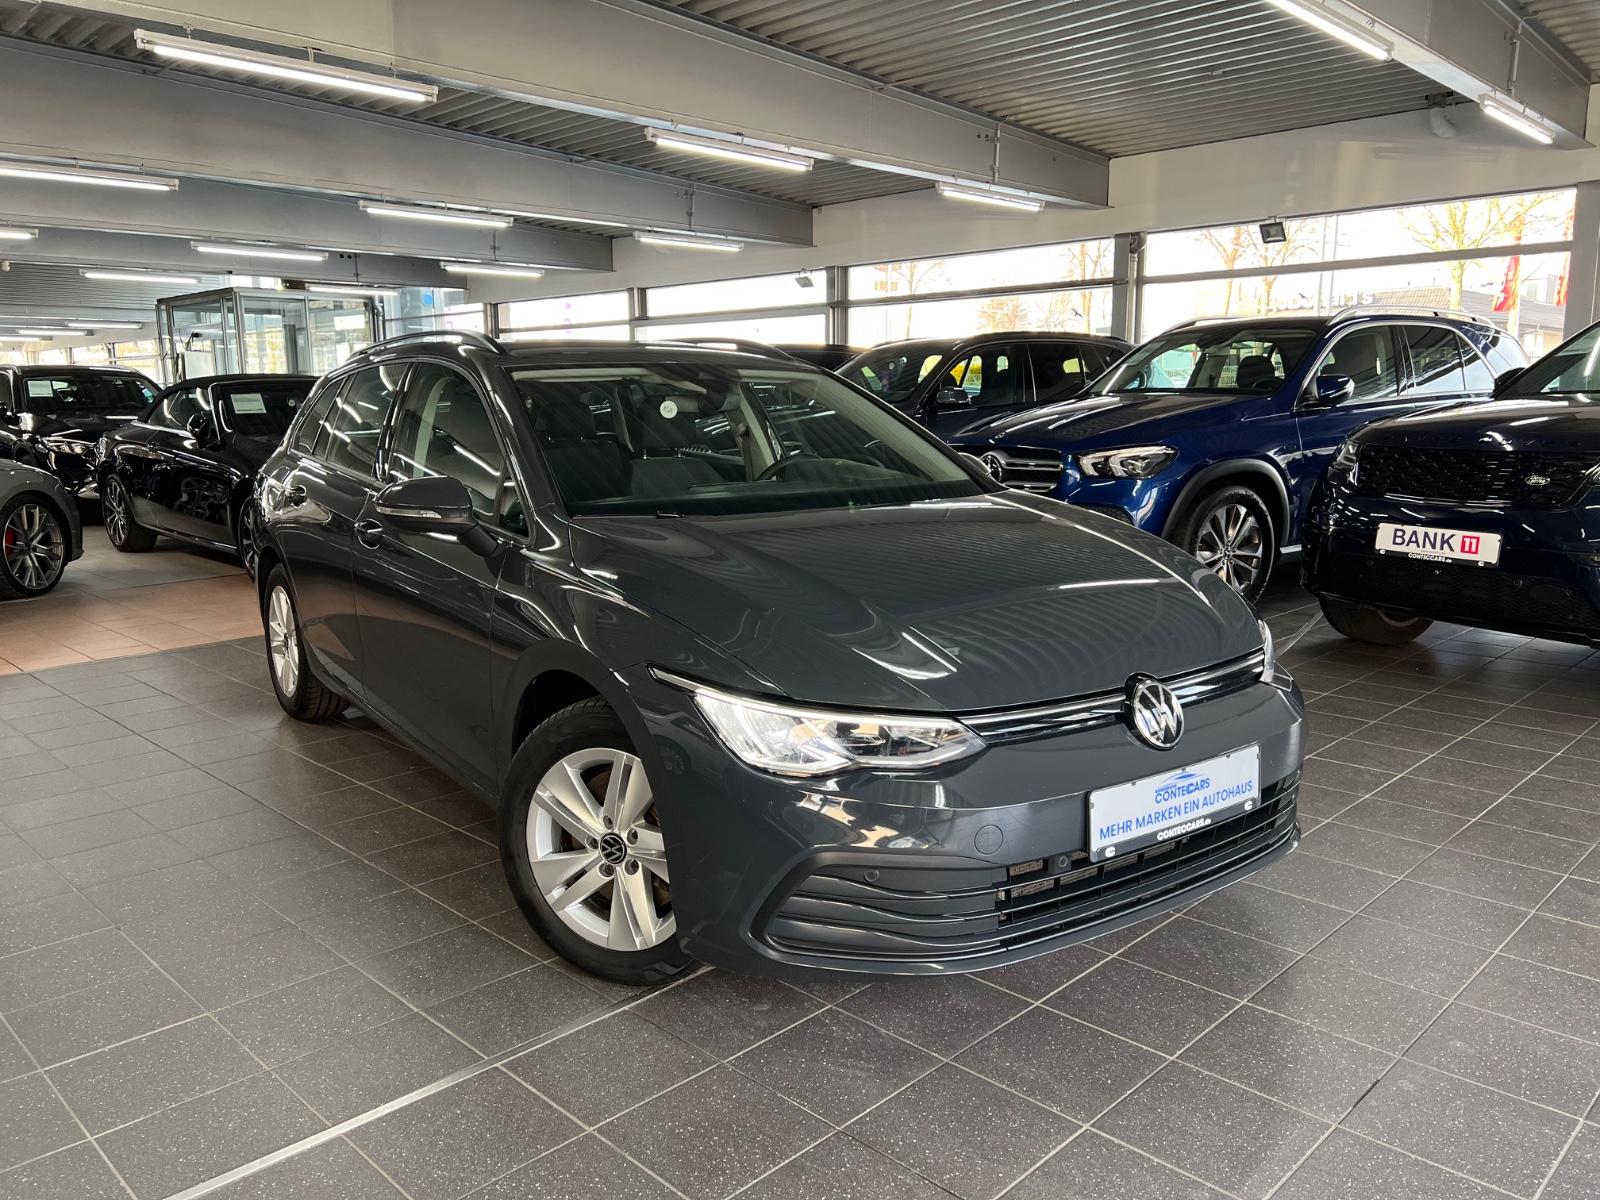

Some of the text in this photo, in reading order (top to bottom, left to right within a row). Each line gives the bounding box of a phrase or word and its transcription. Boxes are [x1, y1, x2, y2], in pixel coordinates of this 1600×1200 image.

[1392, 528, 1478, 553] BANK 11
[1100, 780, 1253, 840] MEHR MARKEN EIN AUTOHAUS
